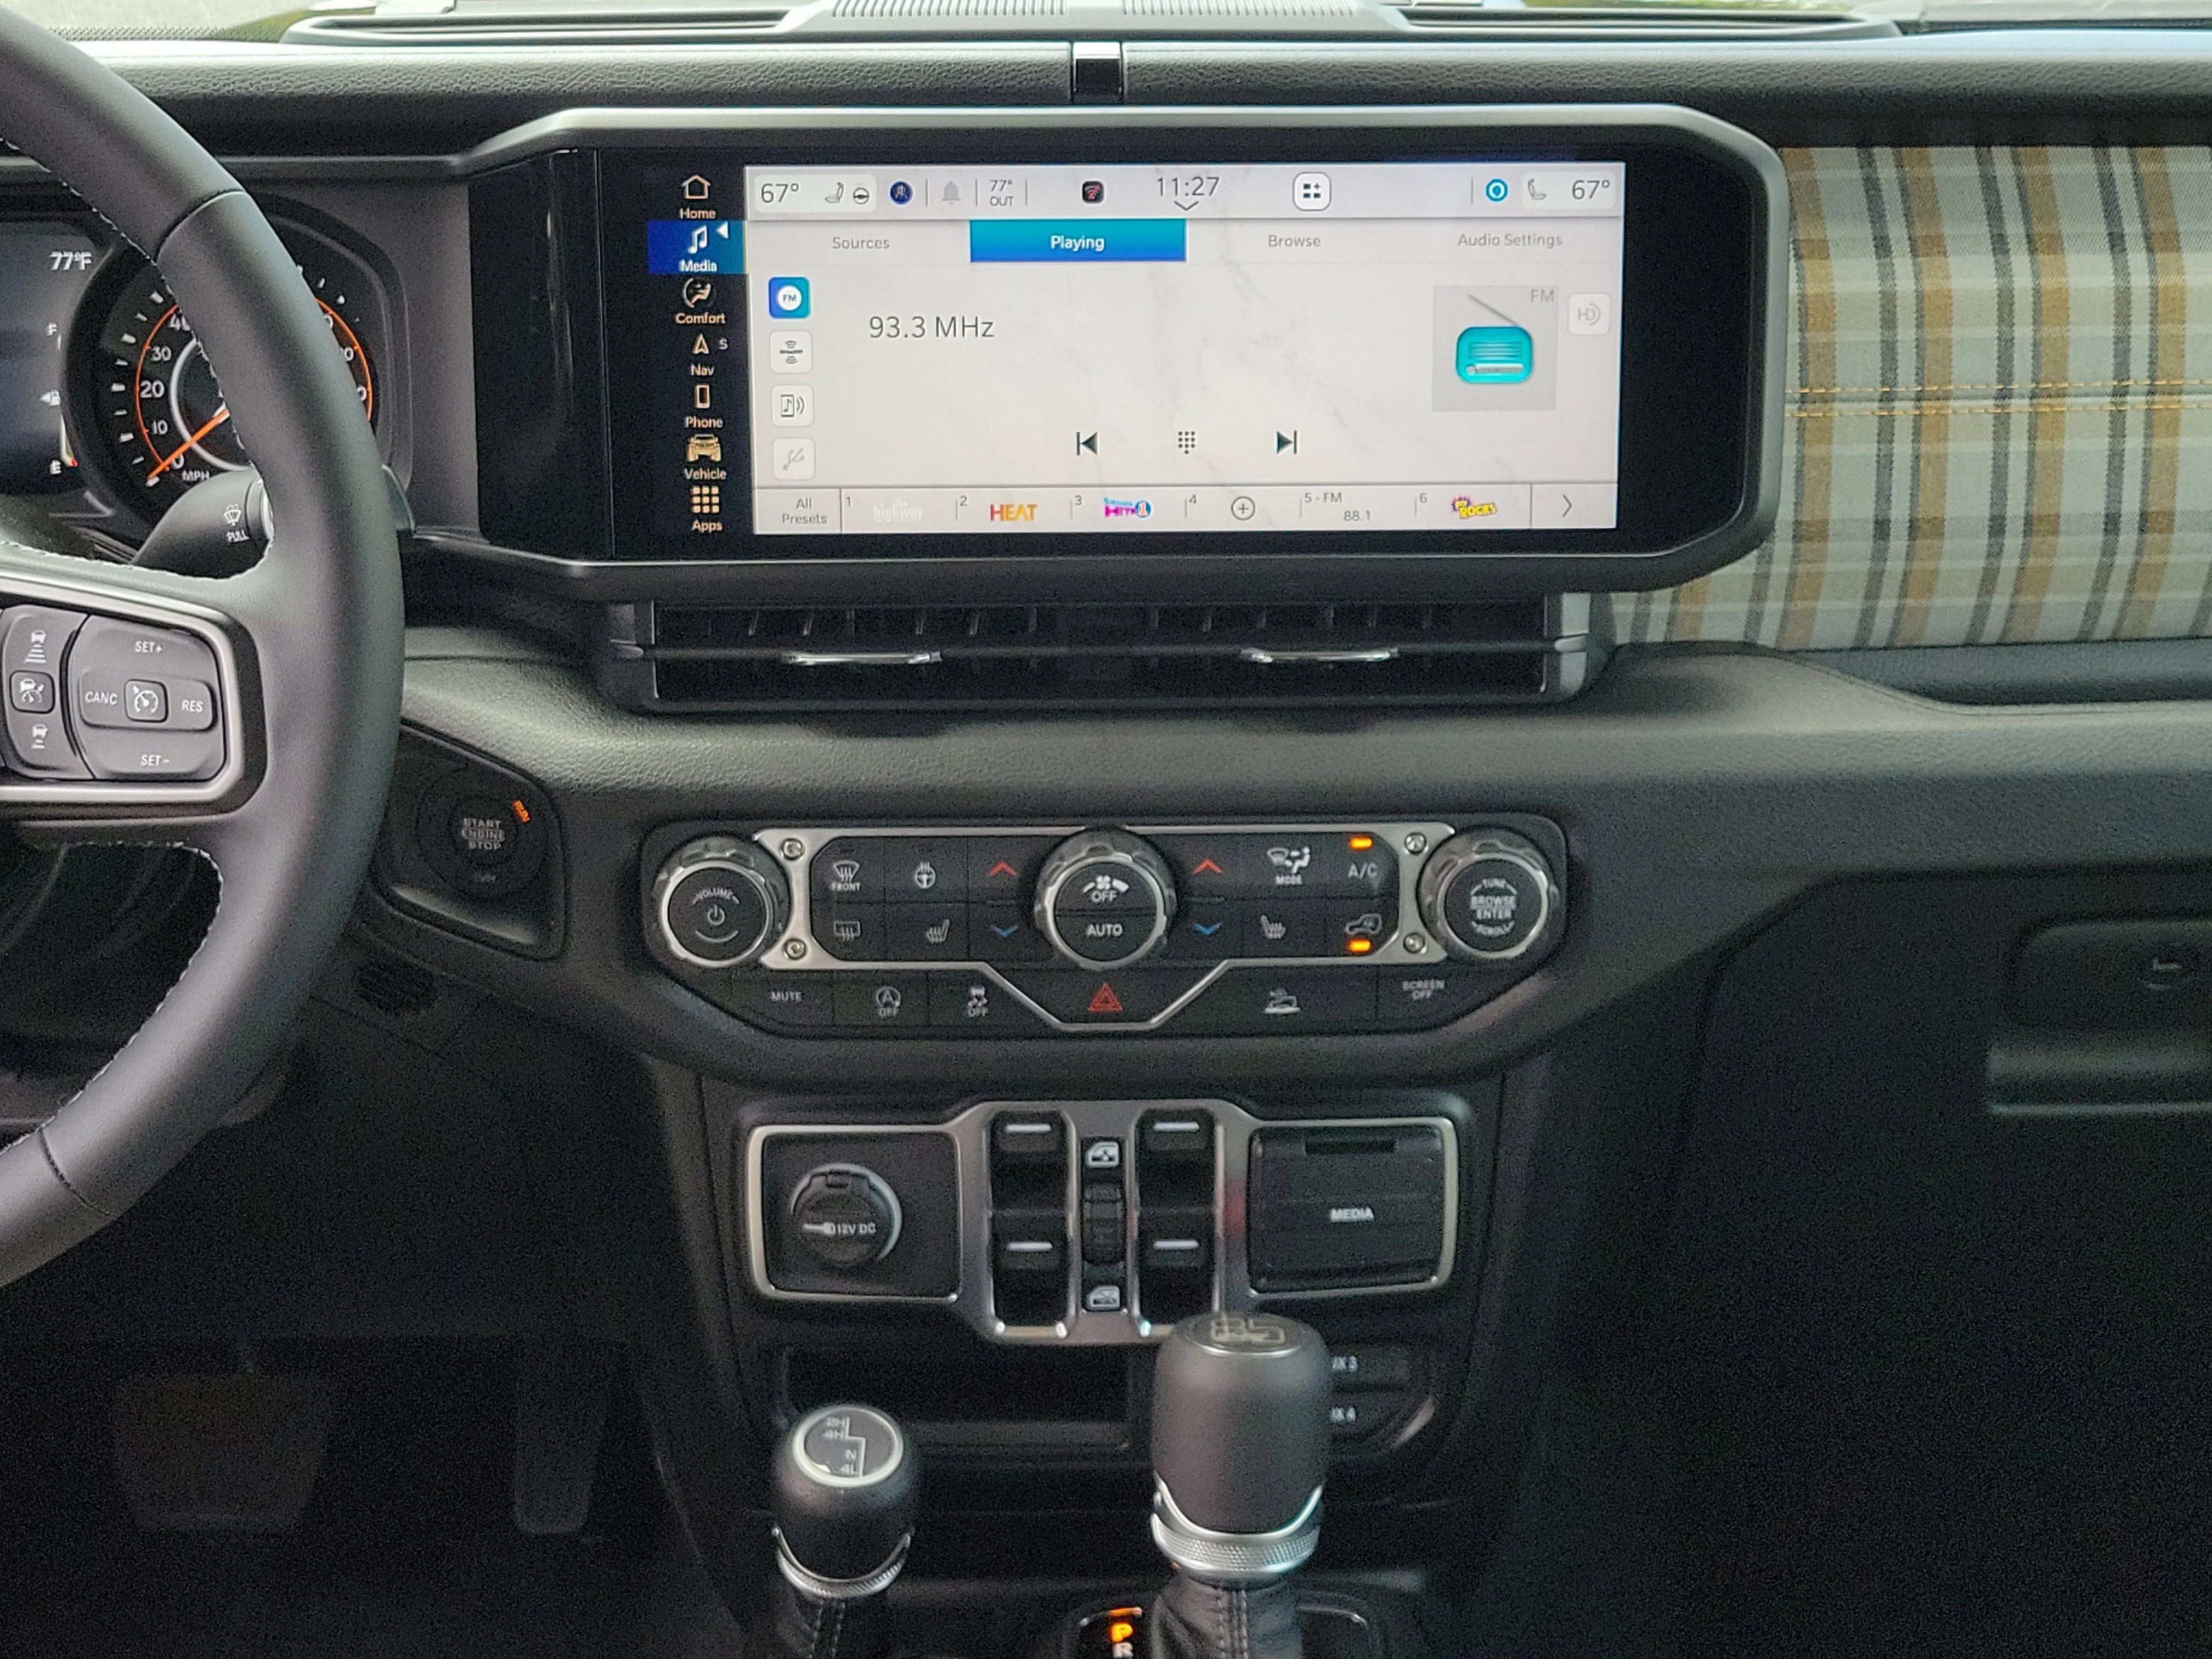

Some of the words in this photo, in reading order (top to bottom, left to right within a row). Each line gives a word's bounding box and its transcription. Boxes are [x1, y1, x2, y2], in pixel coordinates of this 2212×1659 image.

[990, 179, 1013, 191] 77°
[1157, 177, 1220, 196] 11:27
[1571, 179, 1611, 200] 67°
[760, 183, 800, 204] 67°
[990, 196, 1014, 206] OUT
[680, 207, 716, 218] Home
[832, 236, 890, 250] Sources
[1051, 235, 1105, 251] Playing
[1268, 235, 1321, 248] Browse
[1458, 233, 1500, 247] Audio
[1504, 233, 1562, 249] Settings
[679, 258, 717, 272] Media
[783, 294, 797, 302] FM
[1531, 290, 1554, 303] FM
[675, 312, 726, 324] Comfort
[47, 323, 57, 336] F
[870, 316, 926, 338] 93.3
[935, 316, 995, 338] MHz
[718, 337, 728, 349] S
[151, 346, 171, 361] 30
[690, 364, 714, 376] Nav
[140, 380, 165, 398] 20
[153, 419, 168, 435] 10
[685, 416, 723, 428] Phone
[50, 460, 61, 475] E
[171, 454, 185, 469] 0
[182, 470, 210, 481] MPH
[684, 468, 726, 480] Vehicle
[796, 498, 812, 509] All
[847, 497, 851, 507] 1
[960, 496, 967, 506] 2
[1075, 496, 1082, 506] 3
[1189, 494, 1197, 504] 4
[1323, 493, 1342, 503] FM
[1420, 493, 1427, 503] 6
[990, 504, 1037, 522] HEAT
[1344, 511, 1371, 521] 88.1
[783, 514, 827, 525] Presets
[692, 520, 723, 533] Apps
[227, 528, 250, 543] PULL
[86, 691, 118, 705] CANC
[182, 701, 204, 713] RES
[1348, 862, 1378, 879] A/C
[831, 882, 861, 891] FRONT
[698, 887, 734, 900] VOLUME
[1092, 891, 1118, 902] OFF
[1471, 895, 1516, 909] BROWSE
[1476, 909, 1513, 920] ENTER
[1086, 923, 1123, 937] AUTO
[771, 992, 802, 1001] MUTE
[879, 1007, 899, 1017] OFF
[968, 1007, 988, 1017] OFF
[1330, 1207, 1374, 1222] MEDIA
[837, 1223, 856, 1234] 12V
[859, 1221, 877, 1234] DC
[824, 1429, 845, 1441] 4H
[839, 1464, 859, 1475] 4L
[1111, 1622, 1133, 1642] P
[1113, 1643, 1134, 1658] R
